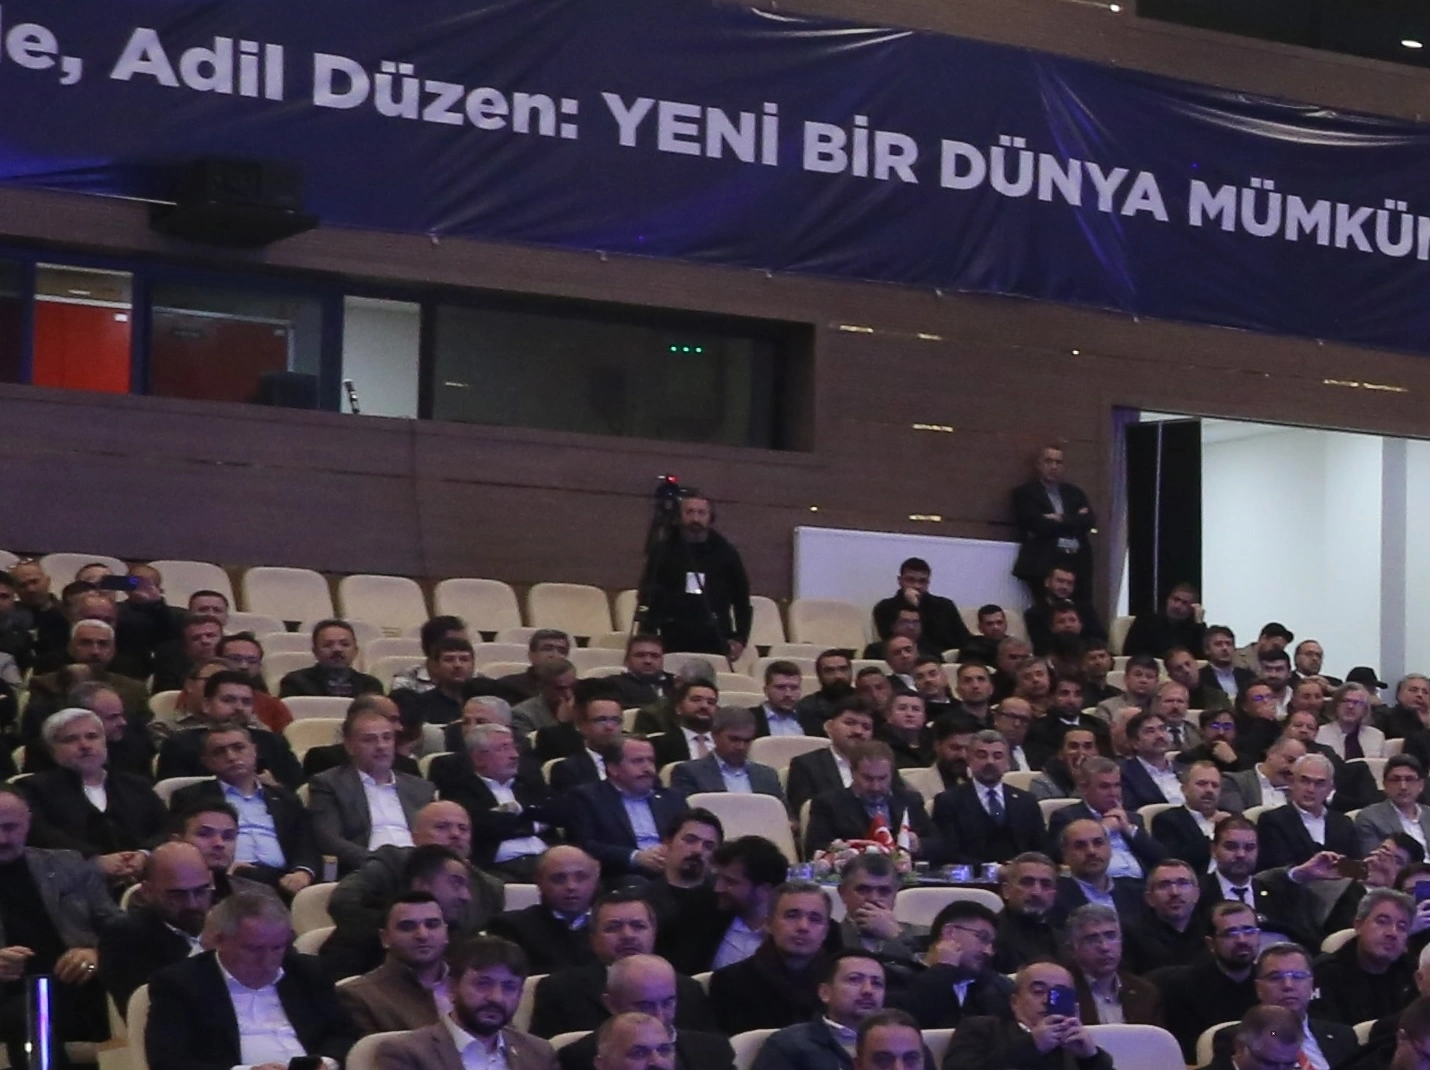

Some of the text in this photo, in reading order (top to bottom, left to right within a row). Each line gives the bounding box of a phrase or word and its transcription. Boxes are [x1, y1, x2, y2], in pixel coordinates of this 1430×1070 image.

[0, 5, 83, 85] e,
[110, 26, 284, 100] Adil
[313, 52, 578, 139] Düzen:
[601, 92, 779, 166] YENİ
[803, 114, 919, 184] BİR
[941, 135, 1169, 222] DÜNYA
